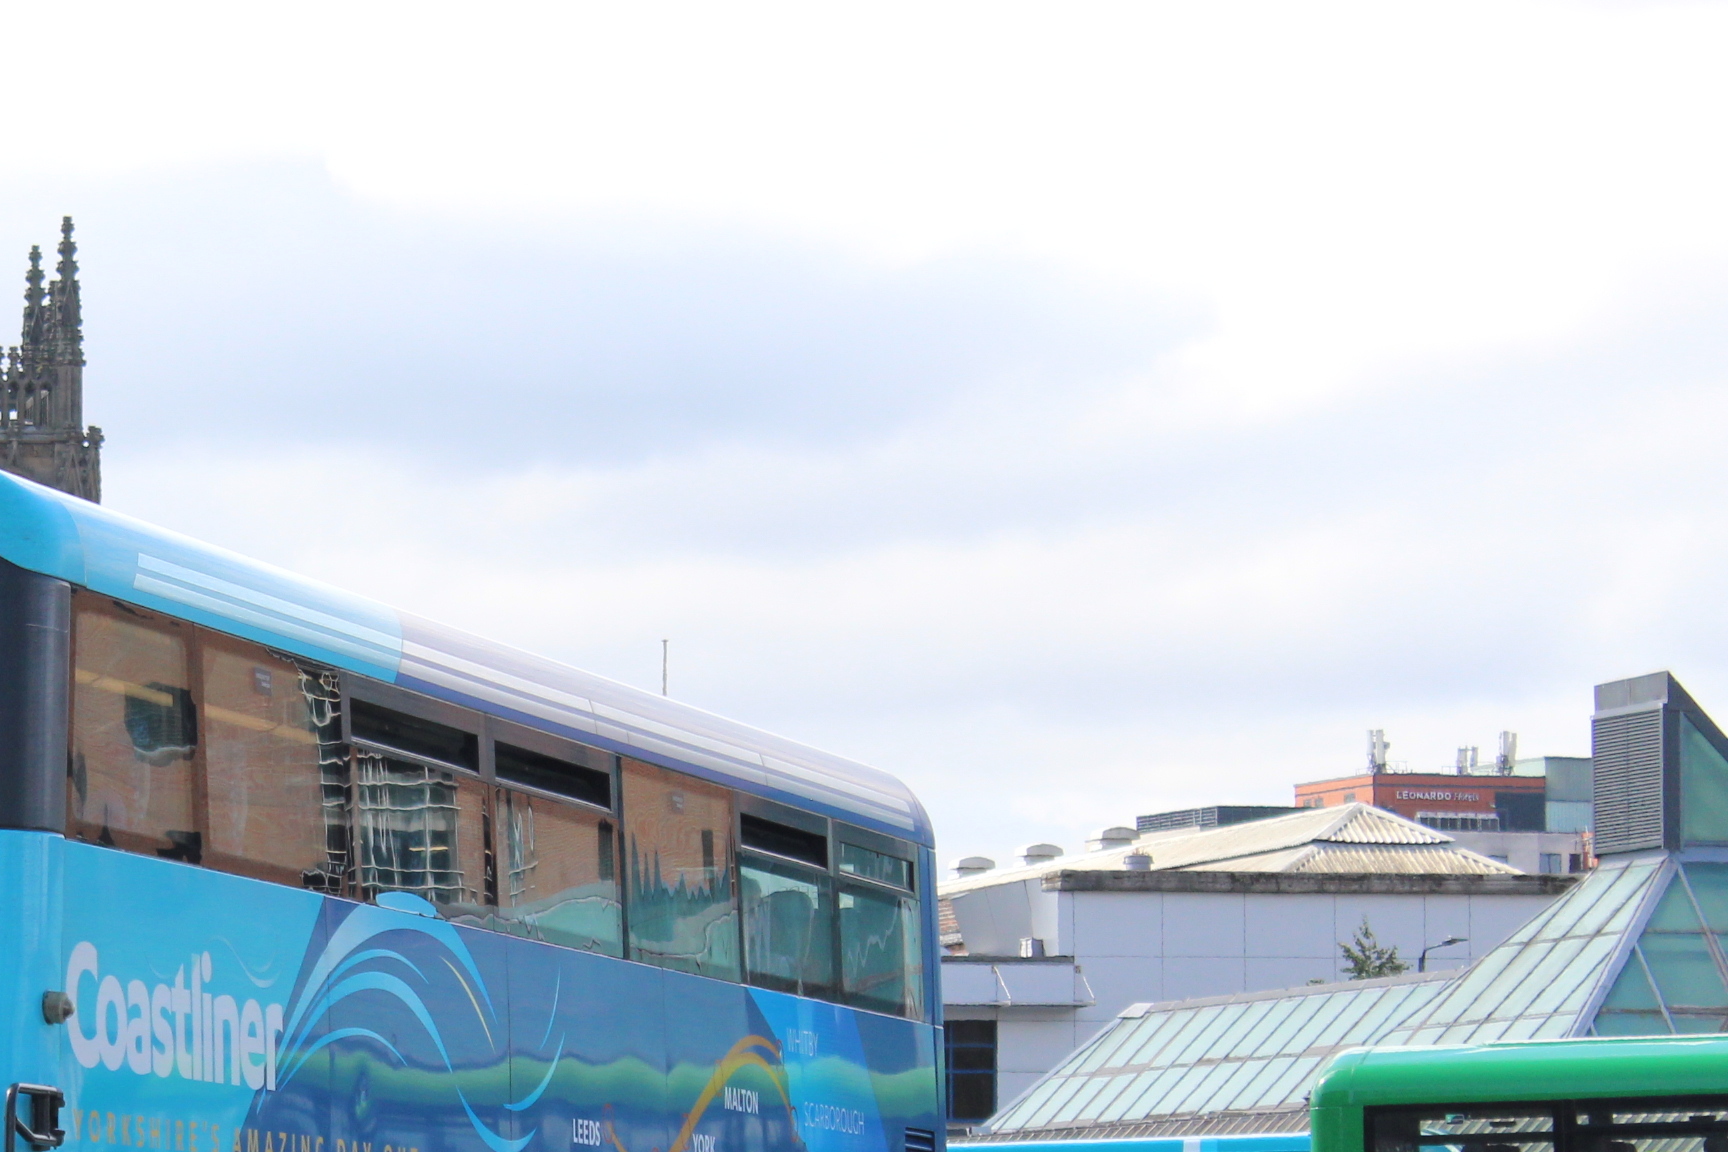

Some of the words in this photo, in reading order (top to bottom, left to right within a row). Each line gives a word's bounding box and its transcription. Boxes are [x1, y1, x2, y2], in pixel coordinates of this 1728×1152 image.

[1396, 790, 1452, 801] LEONARDO
[66, 940, 284, 1092] Coastliner
[786, 1026, 819, 1058] WHITBY
[724, 1085, 760, 1115] MALTON
[572, 1118, 602, 1148] LEEDS
[804, 1101, 866, 1136] SCARBOROUGH
